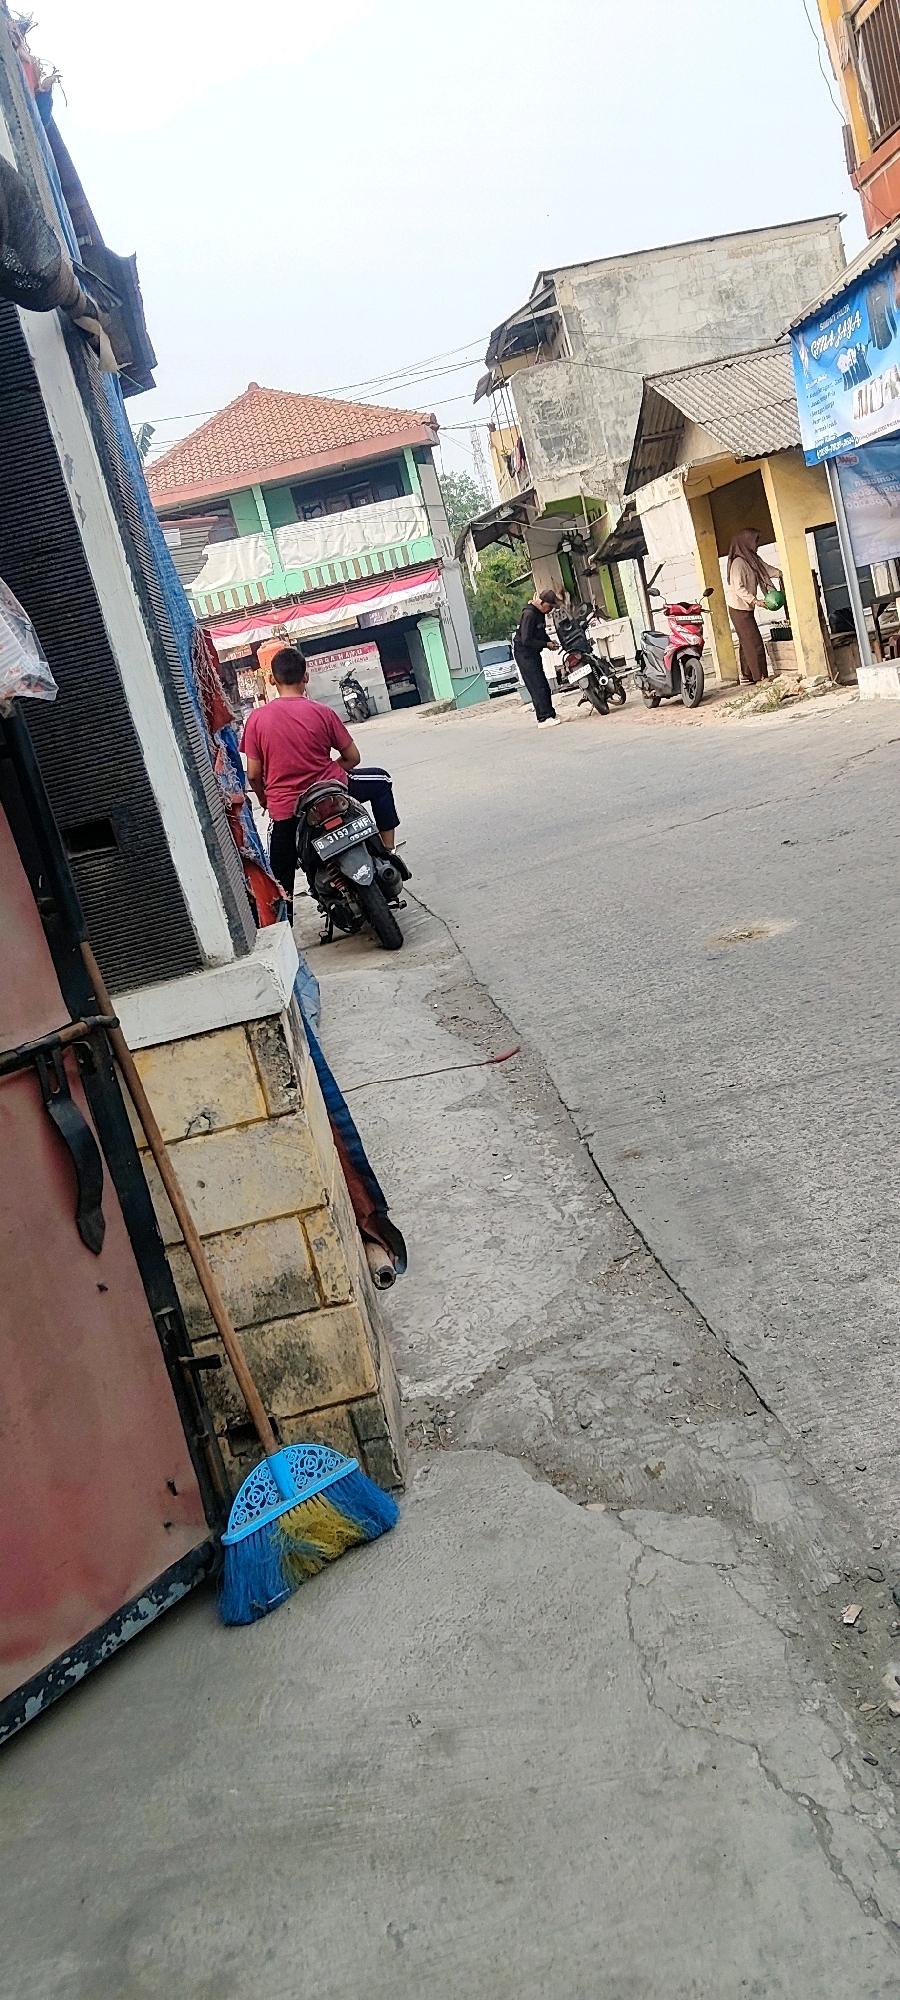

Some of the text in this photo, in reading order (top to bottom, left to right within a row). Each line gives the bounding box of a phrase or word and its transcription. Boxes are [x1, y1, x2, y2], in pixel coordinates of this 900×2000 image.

[835, 310, 862, 348] JAYA
[316, 840, 325, 850] B
[327, 828, 349, 844] 3193
